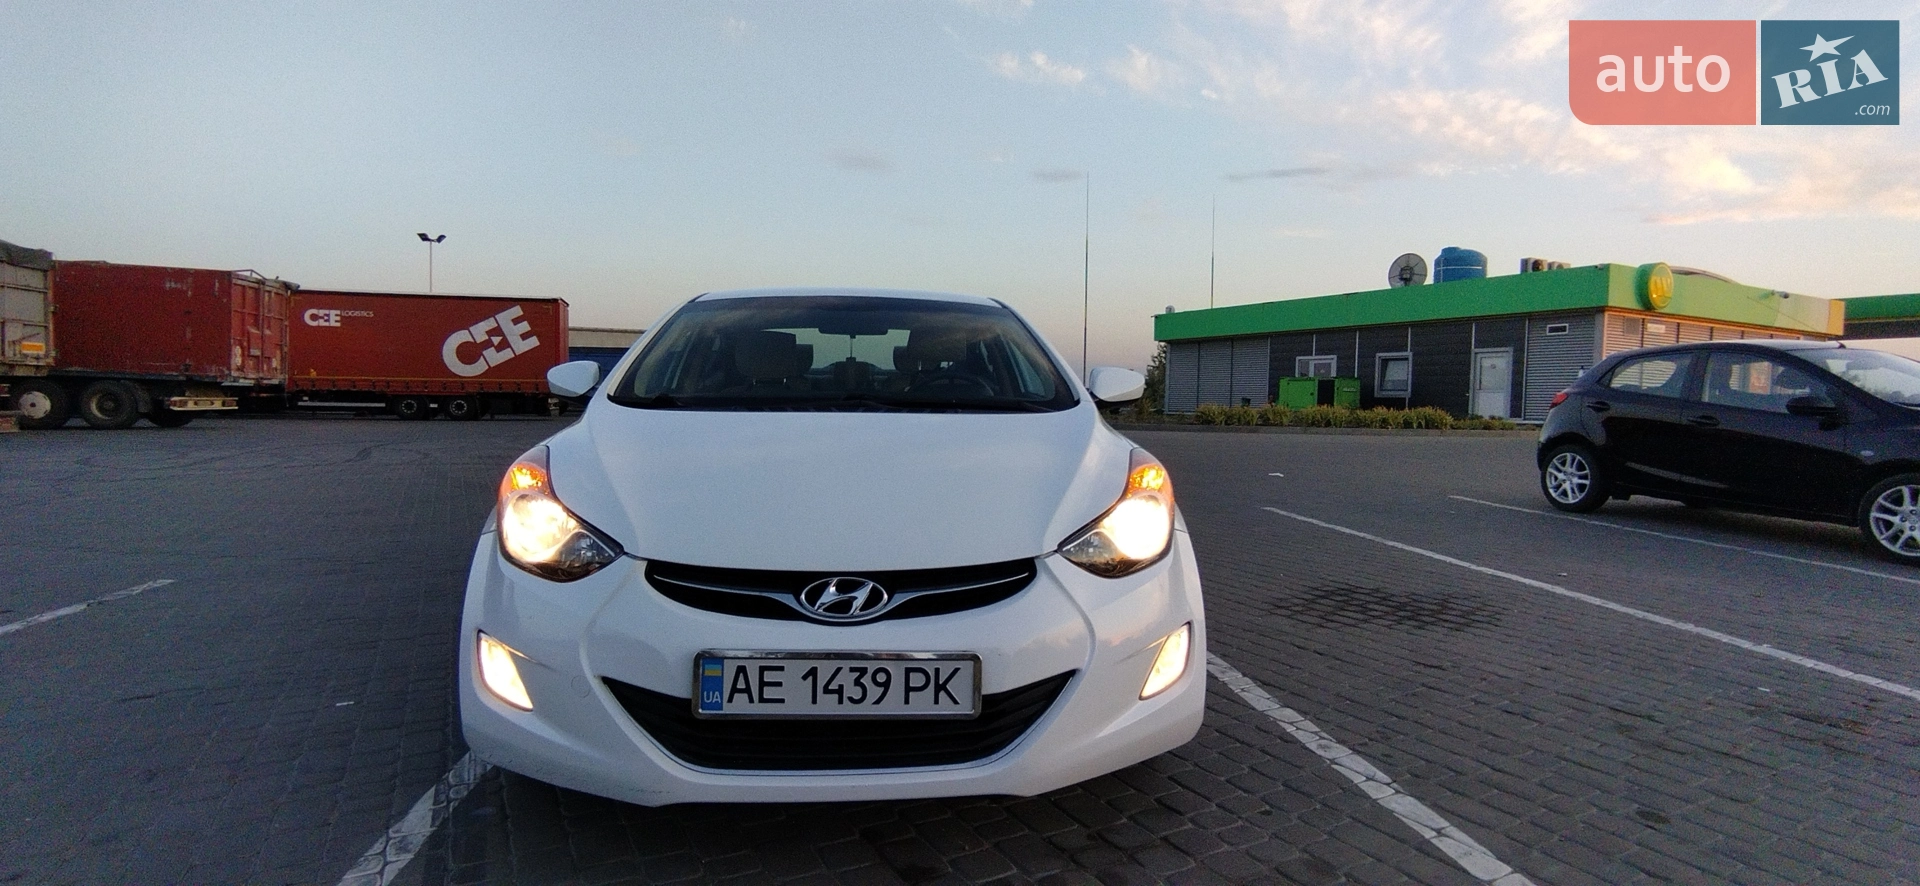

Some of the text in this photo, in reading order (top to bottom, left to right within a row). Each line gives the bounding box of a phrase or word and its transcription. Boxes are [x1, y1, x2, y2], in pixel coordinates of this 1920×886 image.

[304, 308, 341, 327] CEE
[442, 305, 540, 377] CEE
[704, 690, 721, 704] UA
[726, 665, 961, 705] AE 1439 PK
